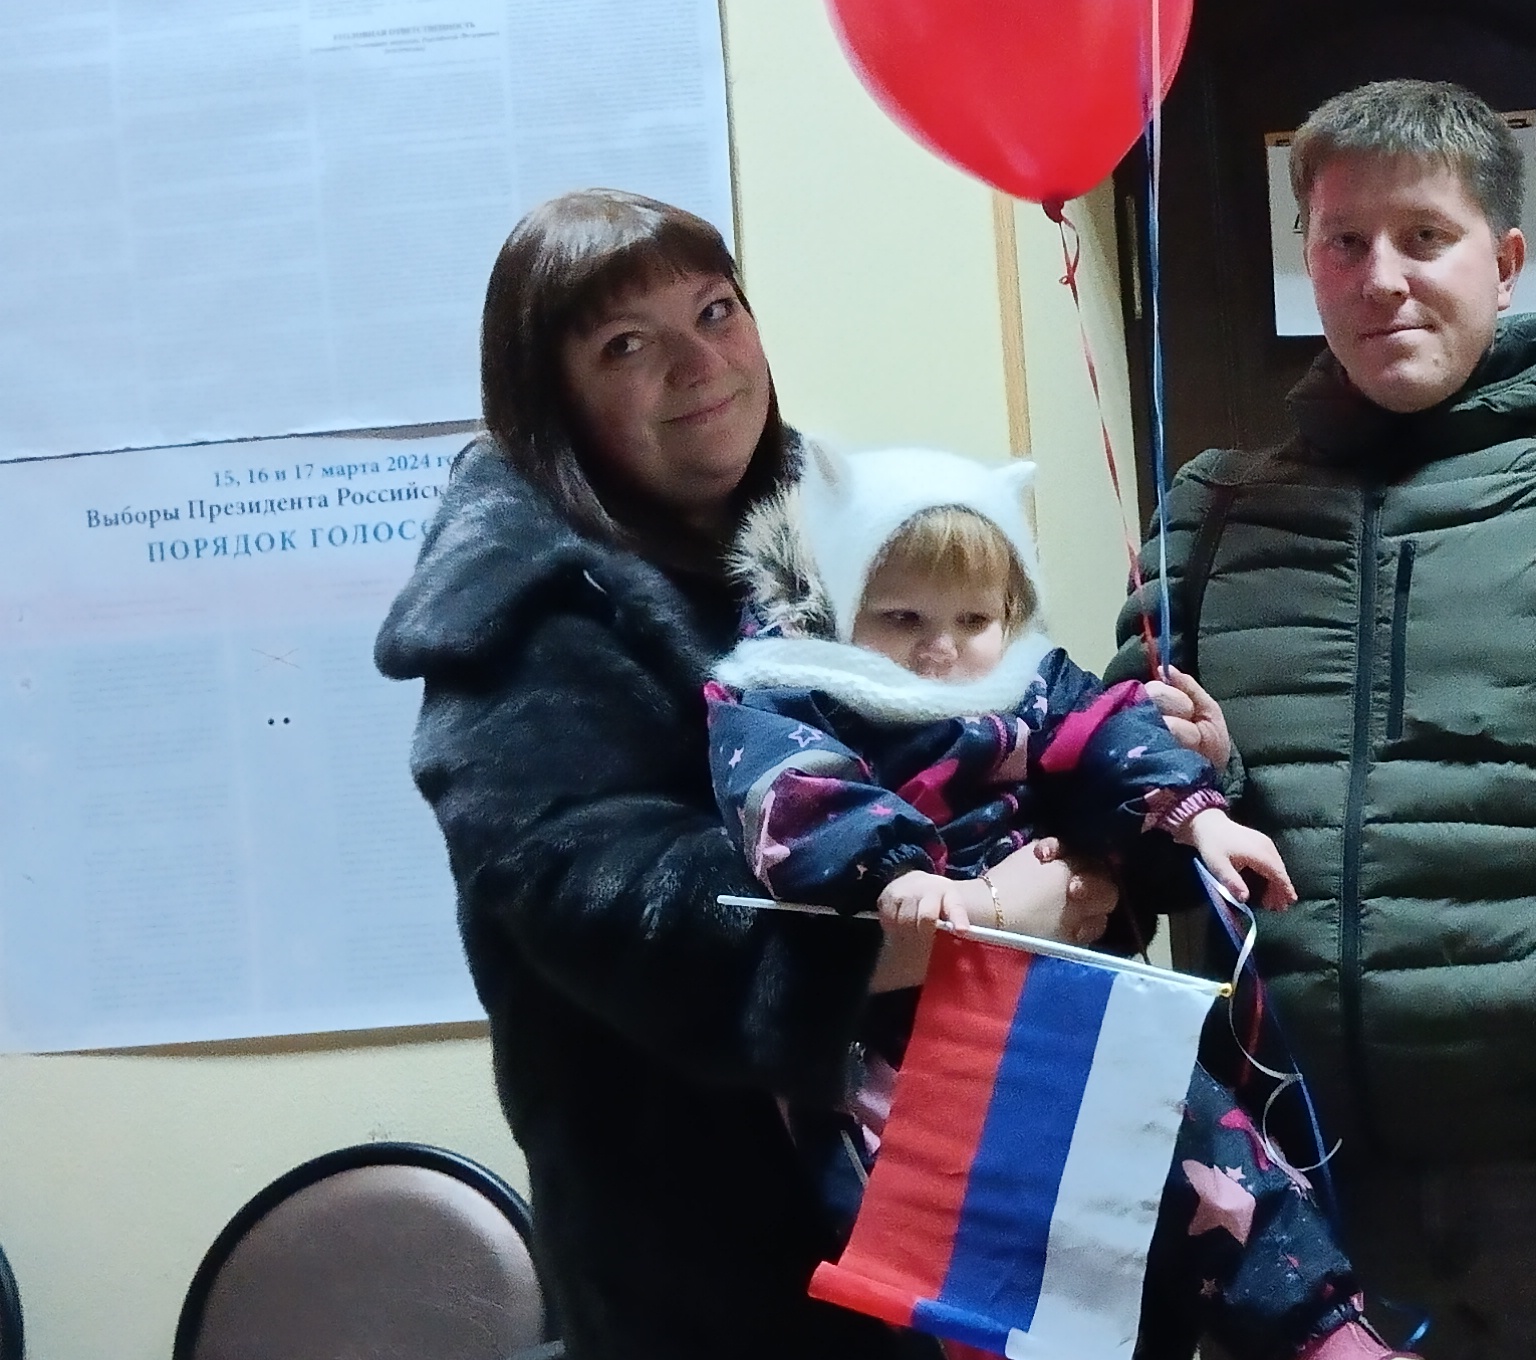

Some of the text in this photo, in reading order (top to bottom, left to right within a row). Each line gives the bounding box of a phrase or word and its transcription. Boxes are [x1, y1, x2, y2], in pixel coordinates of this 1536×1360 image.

[213, 470, 241, 488] 15,
[248, 468, 269, 485] 16
[275, 468, 287, 482] и
[295, 462, 314, 481] 17
[321, 459, 381, 481] марта
[386, 452, 431, 473] 2024
[86, 505, 181, 530] Выборы
[187, 493, 329, 526] Президента
[147, 527, 298, 564] ПОРЯДОК
